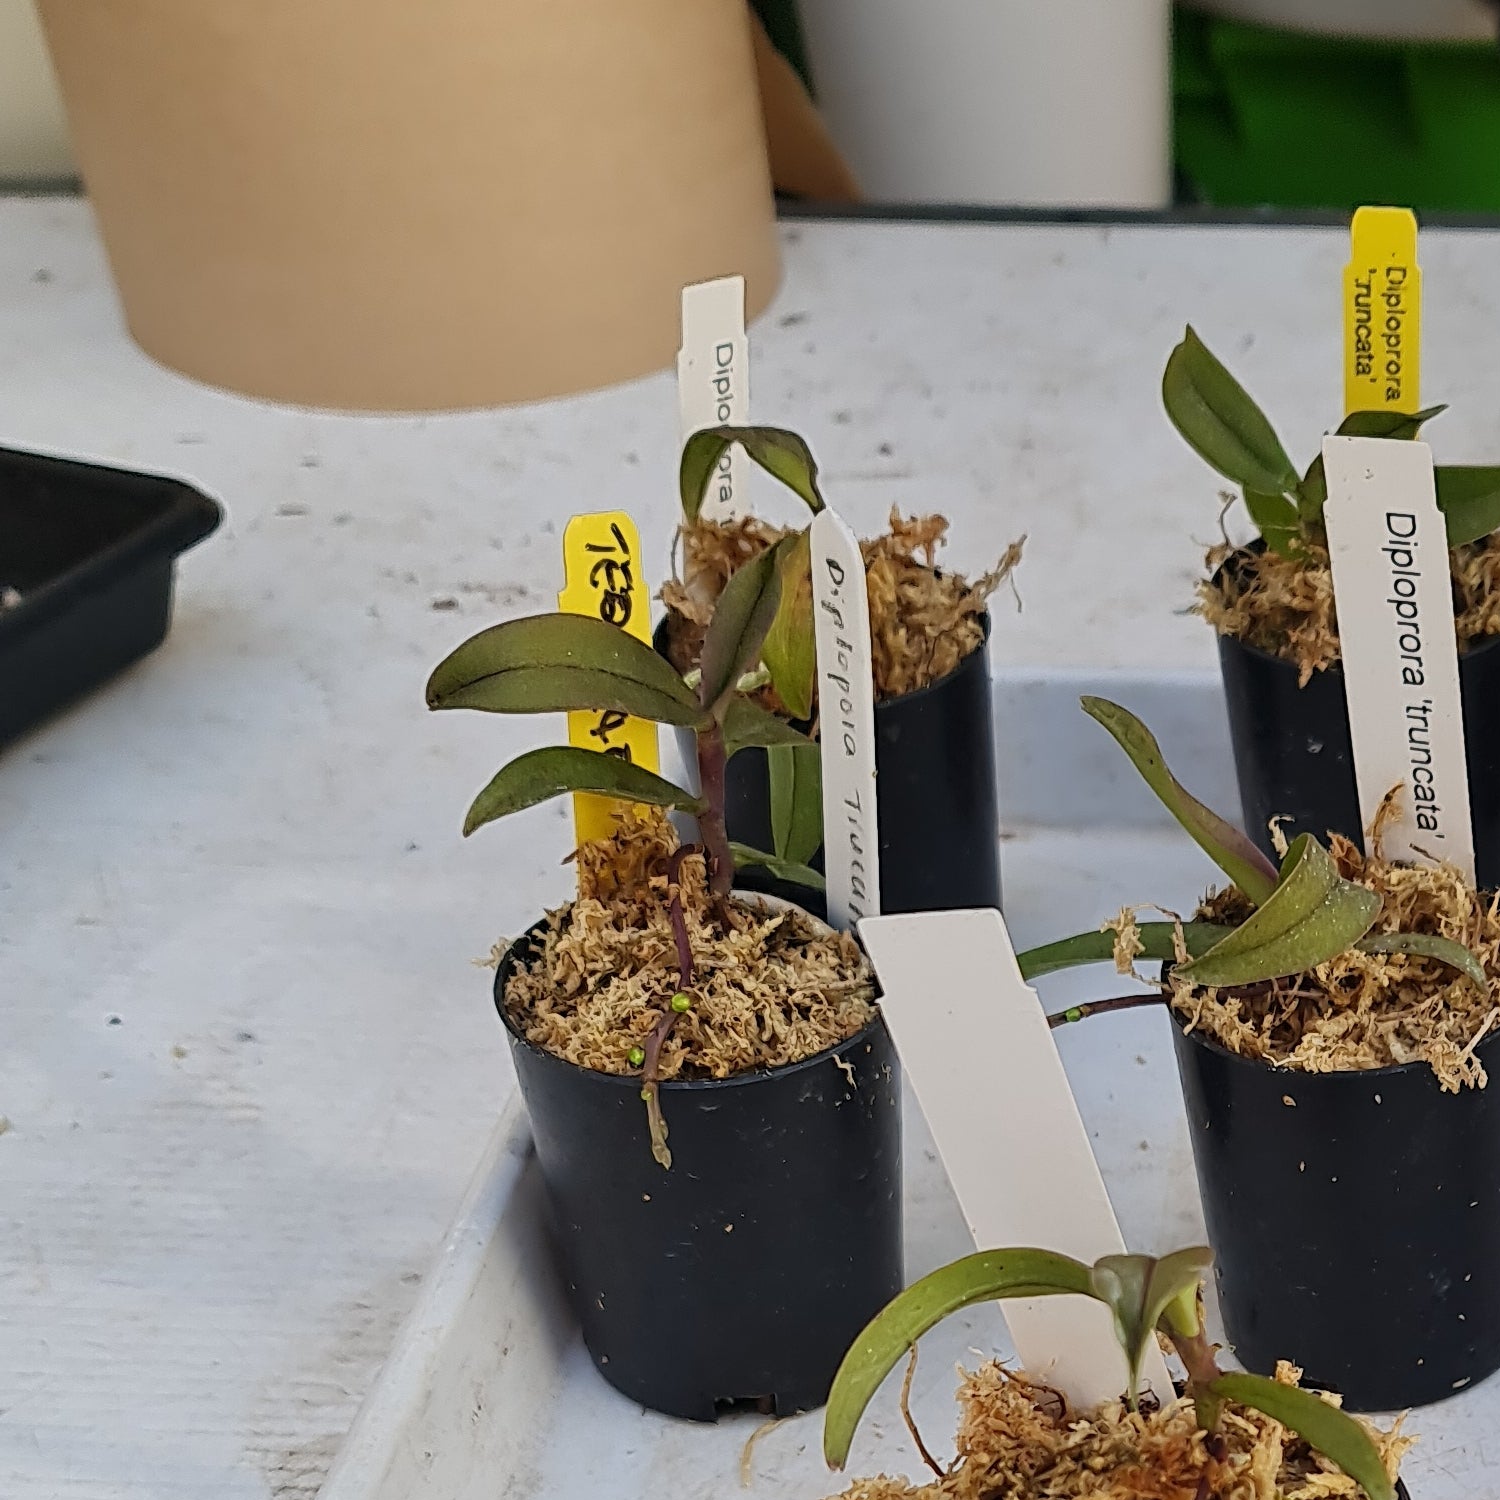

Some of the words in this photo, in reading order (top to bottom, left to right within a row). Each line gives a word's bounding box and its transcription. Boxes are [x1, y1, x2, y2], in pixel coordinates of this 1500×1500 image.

[1381, 266, 1407, 401] Diploprora
[712, 342, 734, 502] Diploora
[1381, 511, 1425, 686] Diploprora
[1406, 699, 1445, 838] 'truncata'
